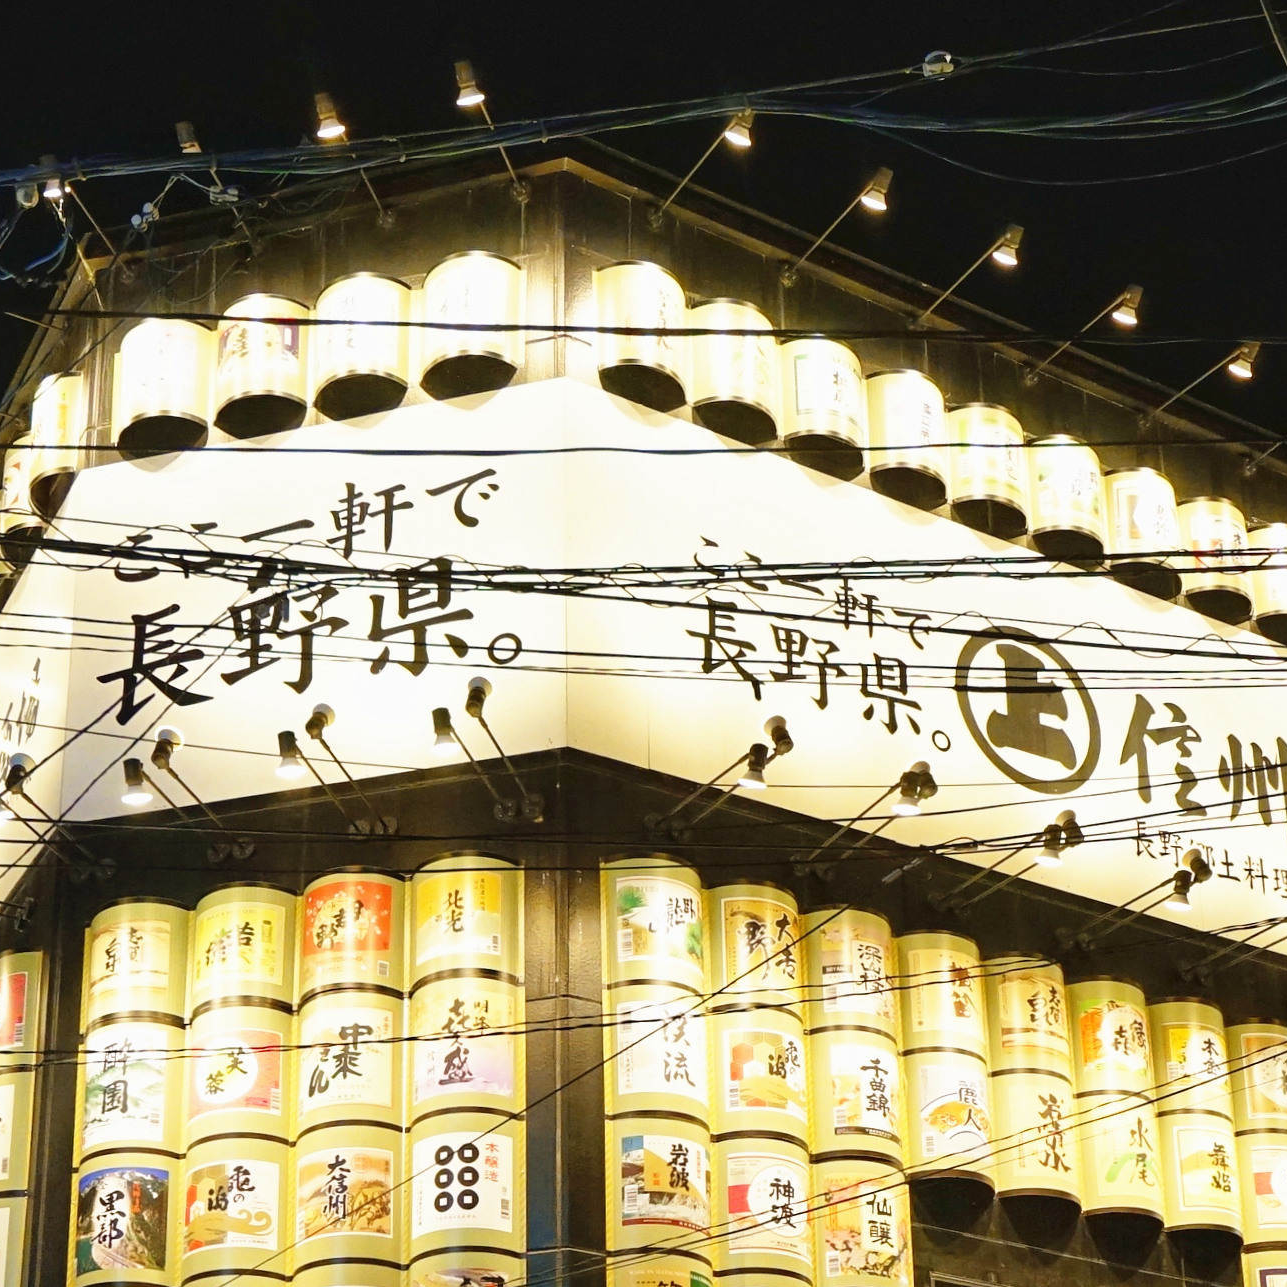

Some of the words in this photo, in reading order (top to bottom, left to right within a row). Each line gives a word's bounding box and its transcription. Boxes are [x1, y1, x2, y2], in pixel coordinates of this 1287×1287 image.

[115, 468, 500, 582] ここ一軒で
[97, 557, 523, 726] 長野県。
[686, 596, 951, 752] 長野県。
[860, 1057, 891, 1119] 千曲錦
[92, 1190, 127, 1249] 黒部
[322, 1153, 350, 1220] 大信州
